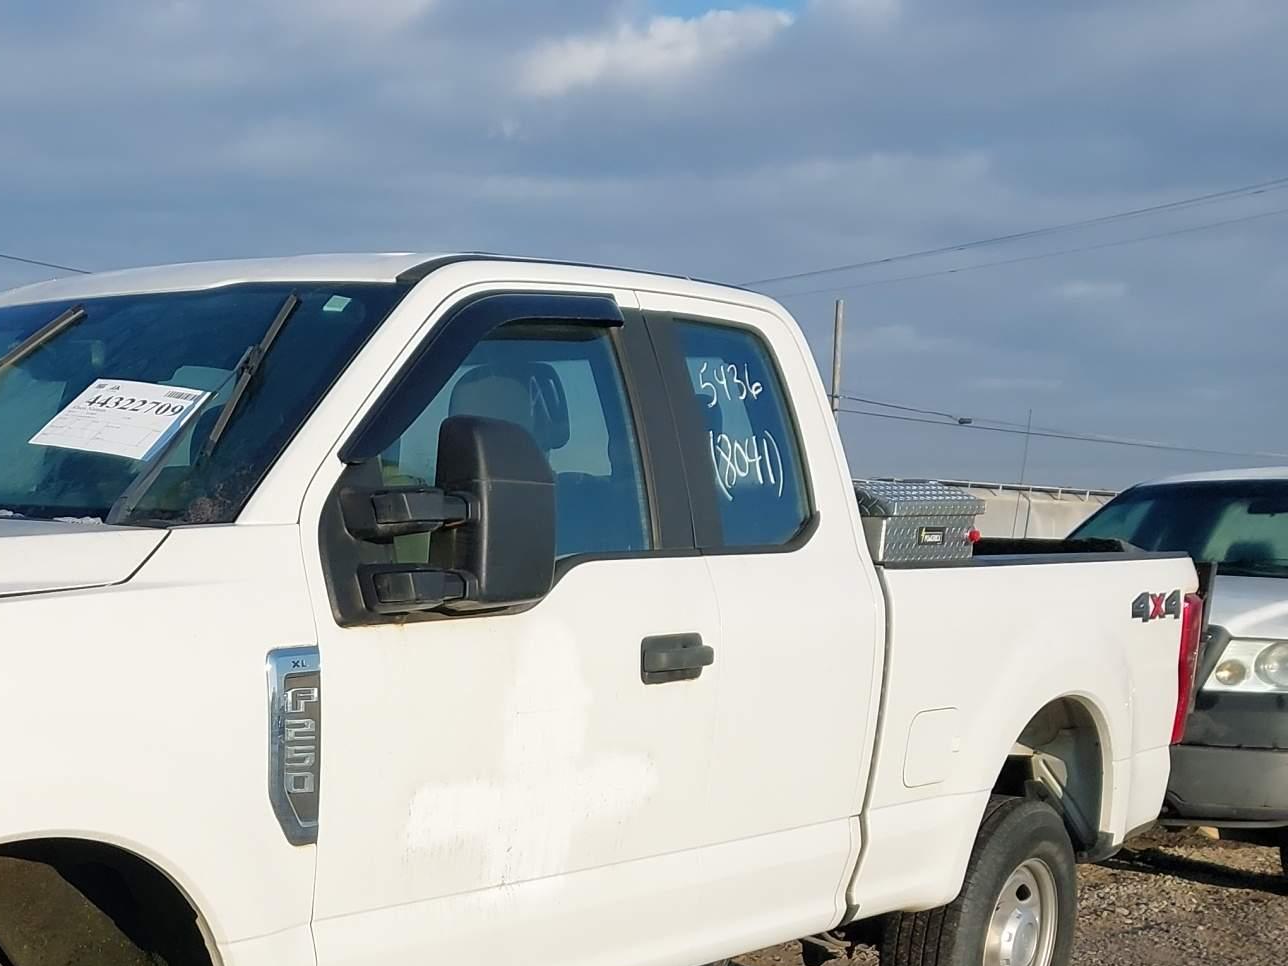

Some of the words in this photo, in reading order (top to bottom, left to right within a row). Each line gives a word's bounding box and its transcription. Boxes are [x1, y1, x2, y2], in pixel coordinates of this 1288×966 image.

[699, 362, 763, 408] 5436
[86, 394, 185, 417] 44322709
[710, 430, 784, 501] (8041)
[292, 660, 307, 668] XL
